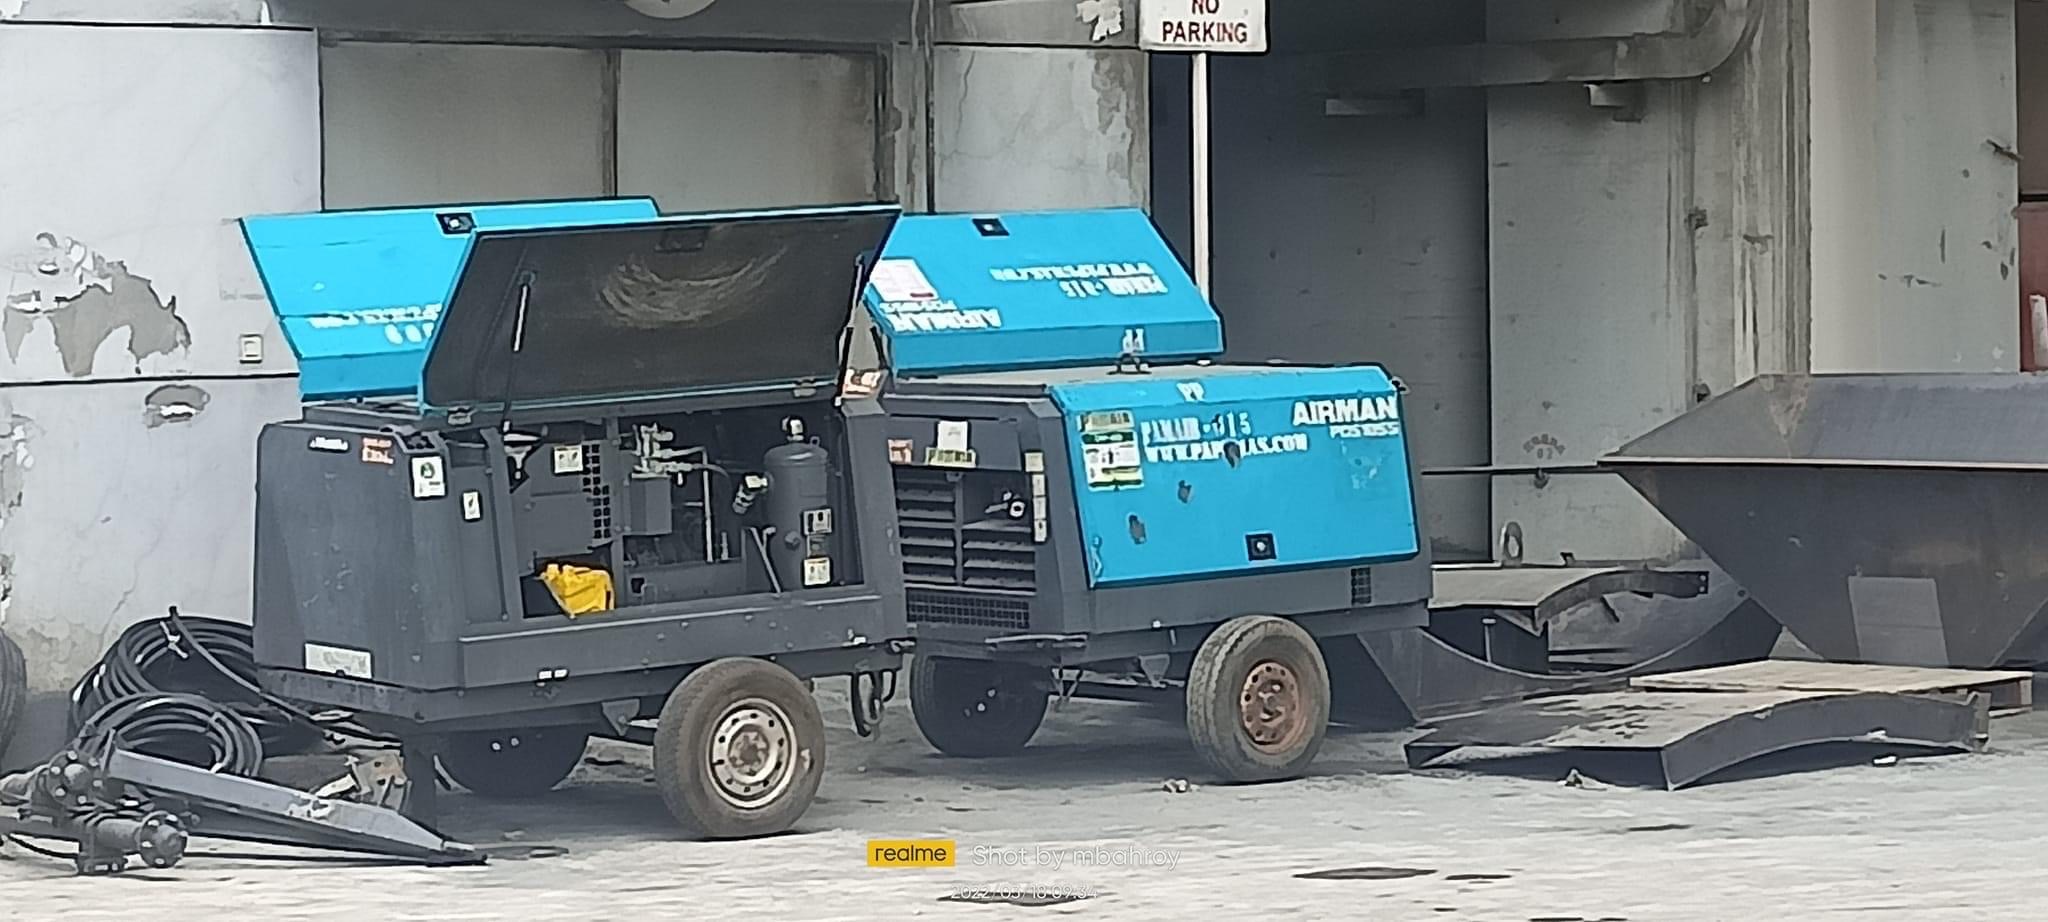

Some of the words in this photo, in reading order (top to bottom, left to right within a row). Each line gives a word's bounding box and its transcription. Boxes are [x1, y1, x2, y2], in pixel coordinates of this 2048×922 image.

[1192, 0, 1220, 14] NO
[1162, 21, 1248, 43] PARKING
[1292, 396, 1398, 426] AIRMAN
